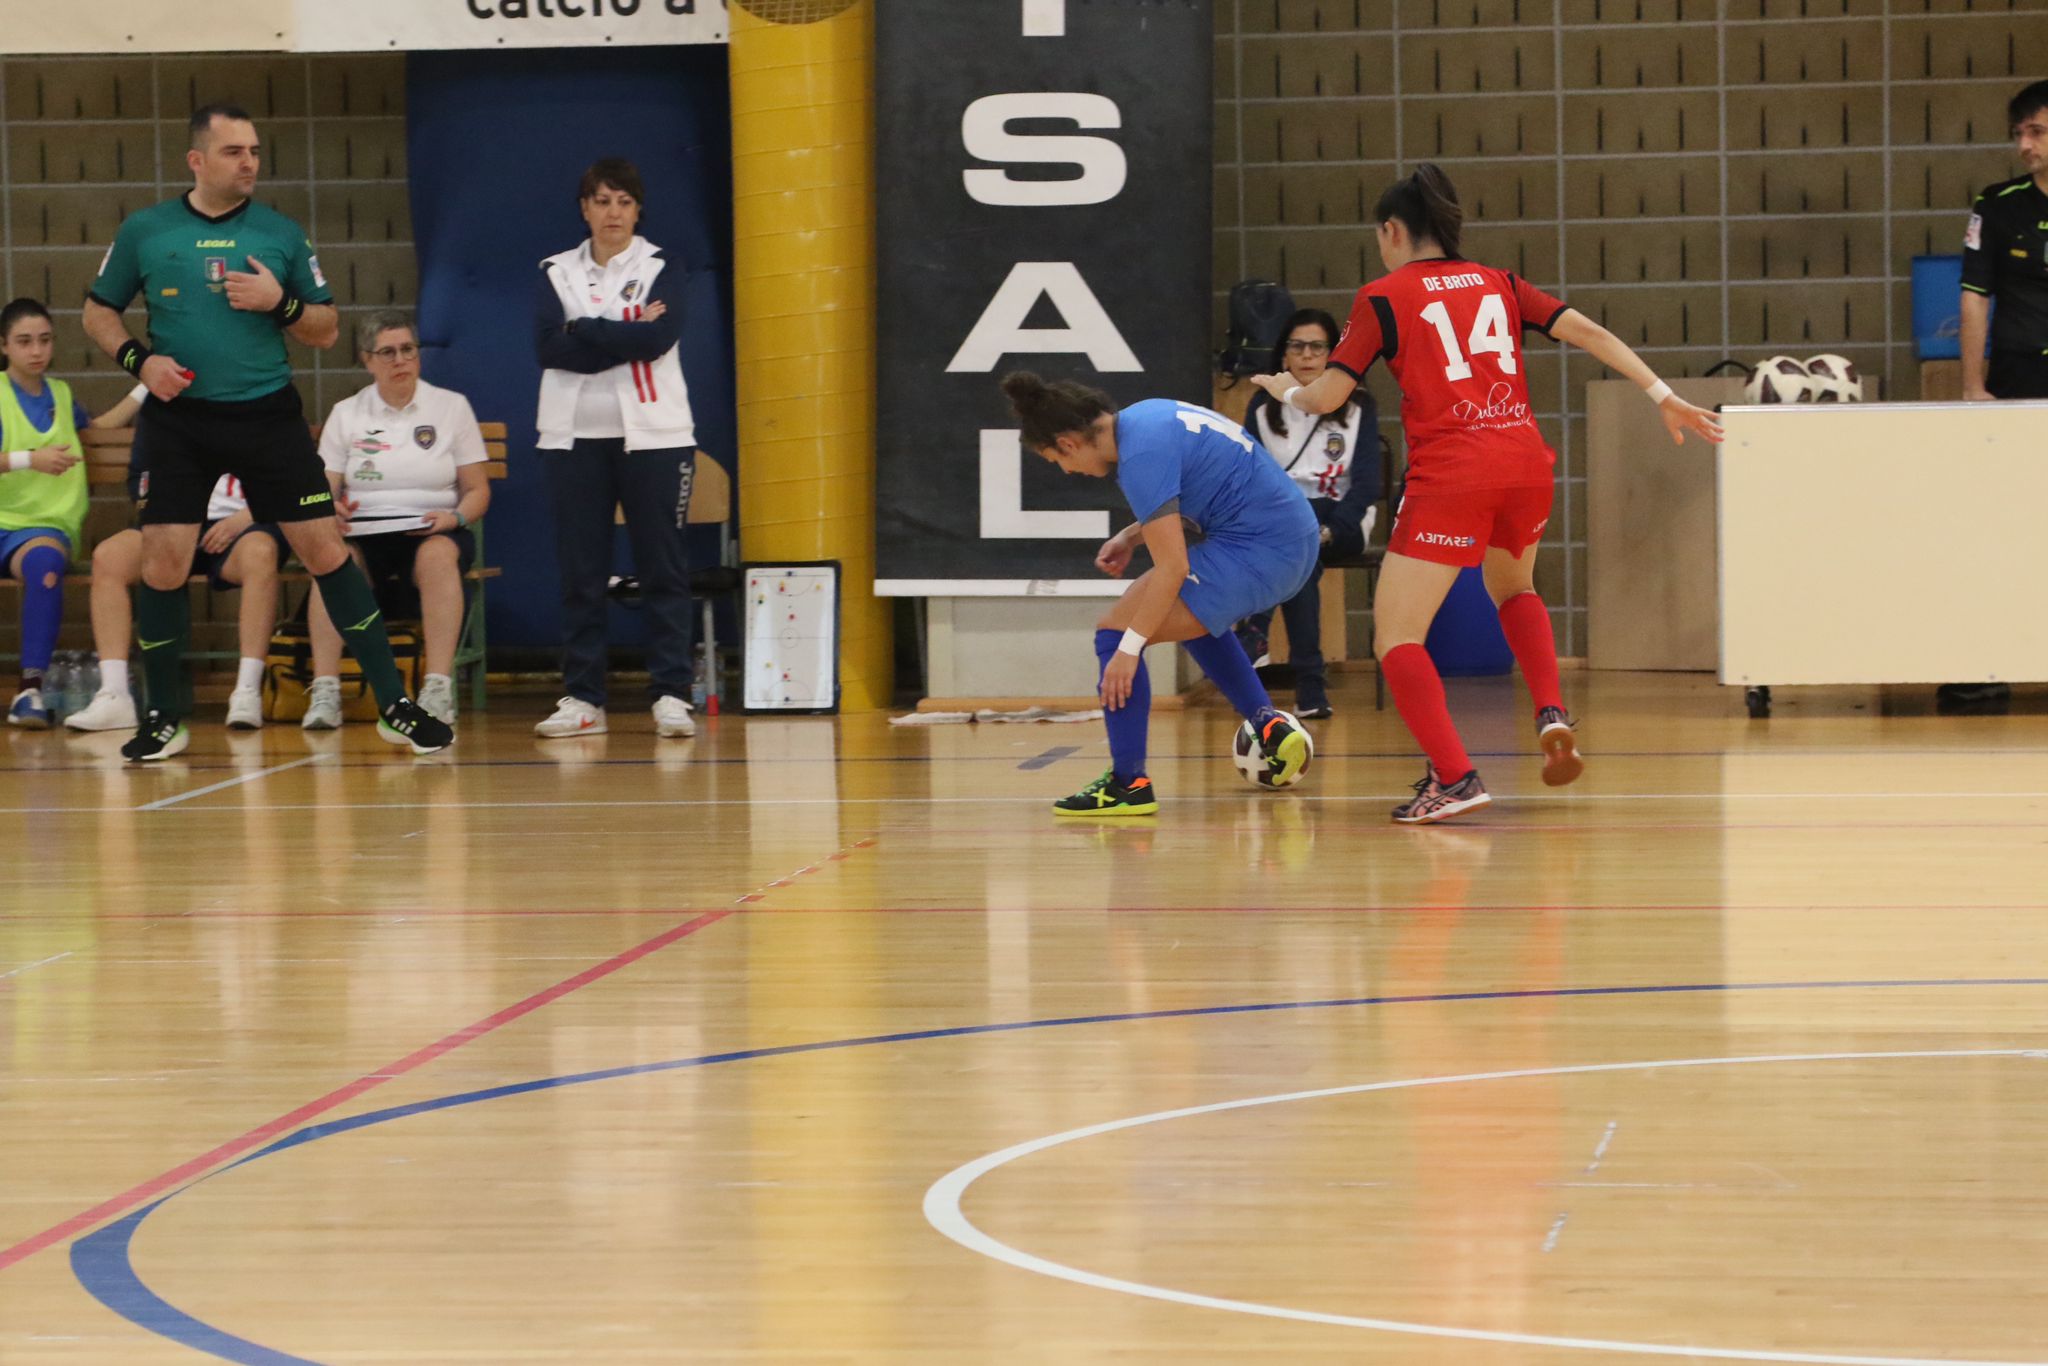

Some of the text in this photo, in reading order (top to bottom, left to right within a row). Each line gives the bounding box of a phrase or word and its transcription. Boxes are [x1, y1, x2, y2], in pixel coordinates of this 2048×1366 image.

[195, 239, 236, 248] LEGEA
[1421, 273, 1485, 292] DE BRITO
[1419, 293, 1518, 382] 14
[299, 491, 332, 507] LEGEA
